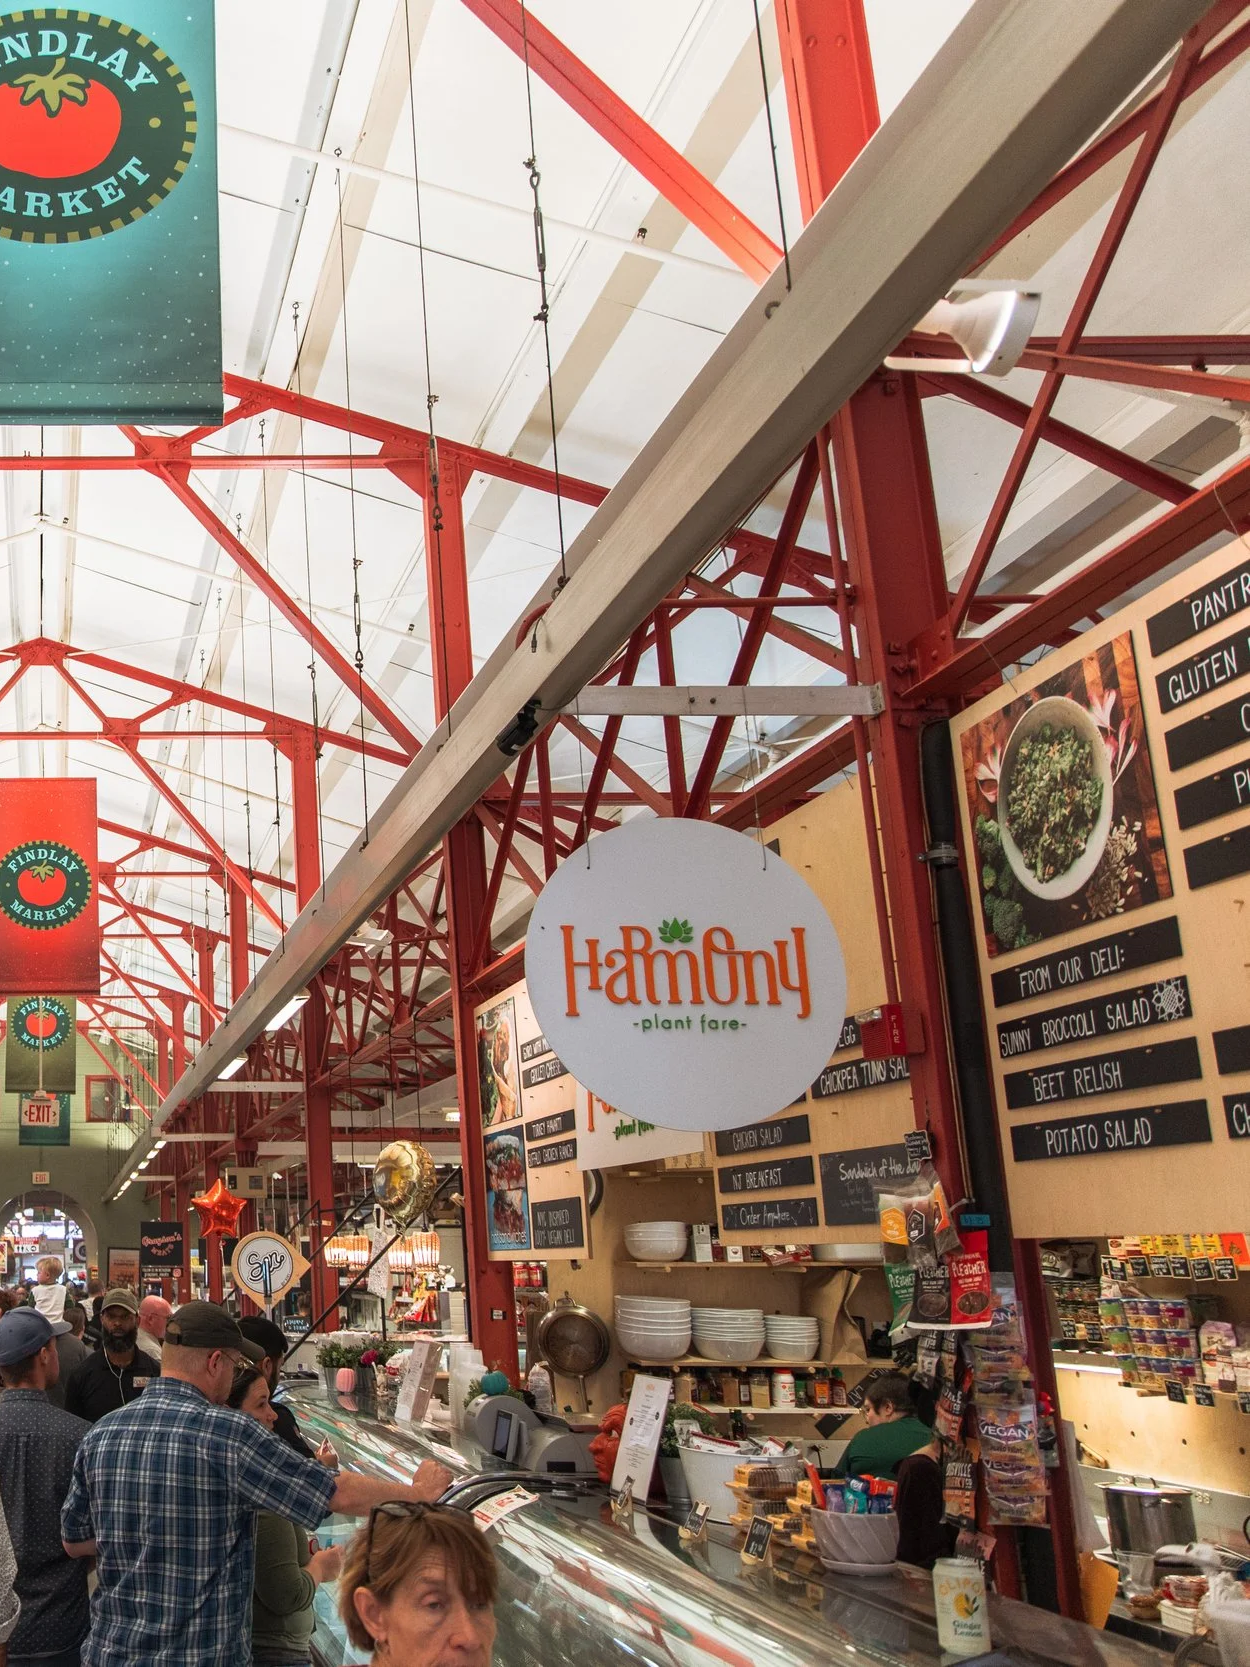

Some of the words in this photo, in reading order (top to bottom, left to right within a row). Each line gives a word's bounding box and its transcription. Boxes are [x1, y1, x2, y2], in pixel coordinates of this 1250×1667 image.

[1168, 646, 1238, 704] GLUTEN
[7, 848, 80, 874] FINDLAY
[9, 896, 77, 922] MARKET
[1019, 968, 1051, 998] FROM
[1058, 958, 1083, 985] OUR
[1091, 945, 1125, 977] DELI:
[891, 1014, 900, 1044] FIRE
[1000, 1028, 1031, 1057] SUNNY
[1042, 1010, 1096, 1047] BROCCOLI
[1106, 998, 1150, 1032] SALAD
[820, 1065, 860, 1095] CHICKPEA
[1032, 1070, 1066, 1102] BEET
[1074, 1061, 1123, 1096] RELISH
[28, 1104, 52, 1123] EXIT
[733, 1131, 758, 1151] CHICKEN
[760, 1127, 783, 1146] SALAD
[1046, 1124, 1098, 1155] POTATO
[1105, 1117, 1152, 1148] SALAD
[746, 1168, 782, 1189] BREAKFAST
[838, 1162, 877, 1180] Sandwich
[878, 1158, 888, 1178] of
[889, 1157, 904, 1176] the
[979, 1425, 1029, 1438] VEGAN
[952, 1620, 982, 1630] Ginger
[954, 1628, 983, 1638] Lemon
